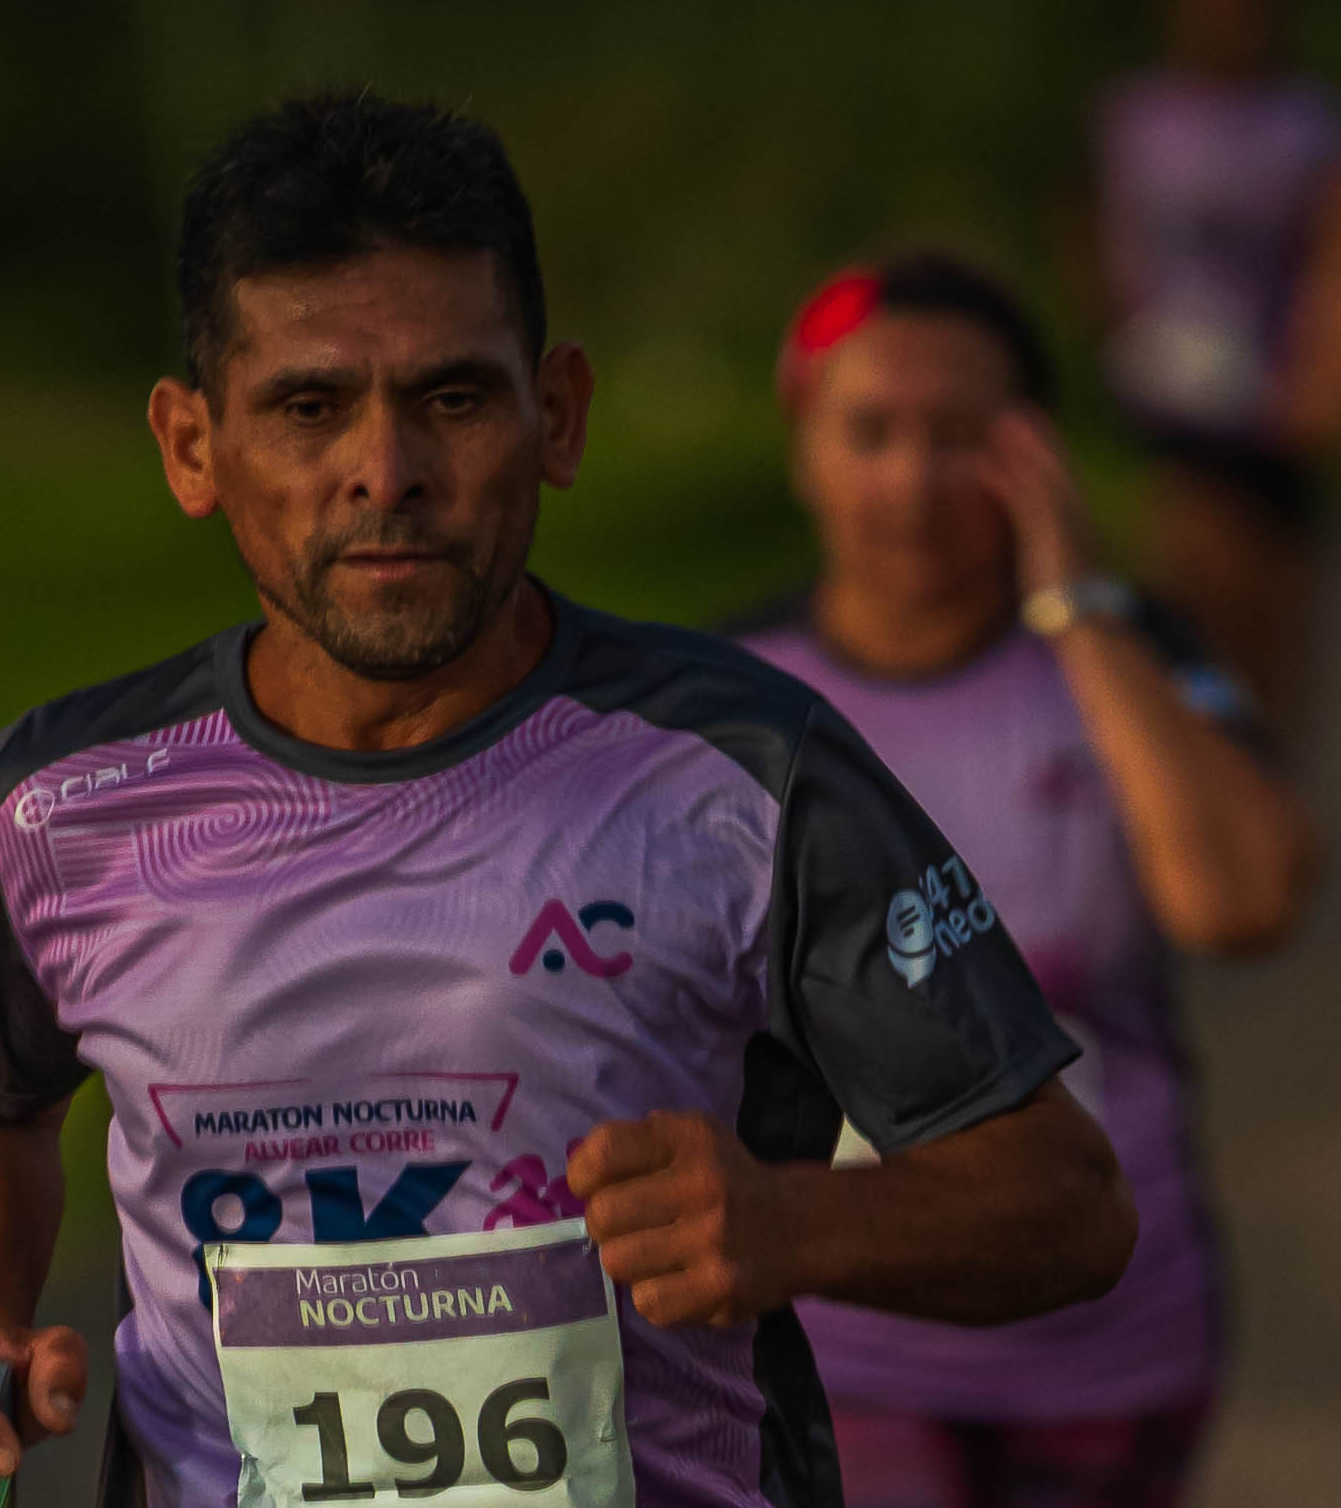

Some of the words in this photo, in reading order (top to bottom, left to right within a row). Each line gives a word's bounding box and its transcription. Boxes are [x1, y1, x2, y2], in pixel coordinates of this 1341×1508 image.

[508, 898, 634, 979] AC
[195, 1103, 323, 1135] MARATON
[332, 1098, 477, 1125] NOCTURNA
[244, 1133, 340, 1164] ALVEAR
[349, 1128, 436, 1154] CORRE
[295, 1261, 420, 1296] Maratón
[298, 1284, 514, 1329] NOCTURNA
[292, 1376, 568, 1502] 196
